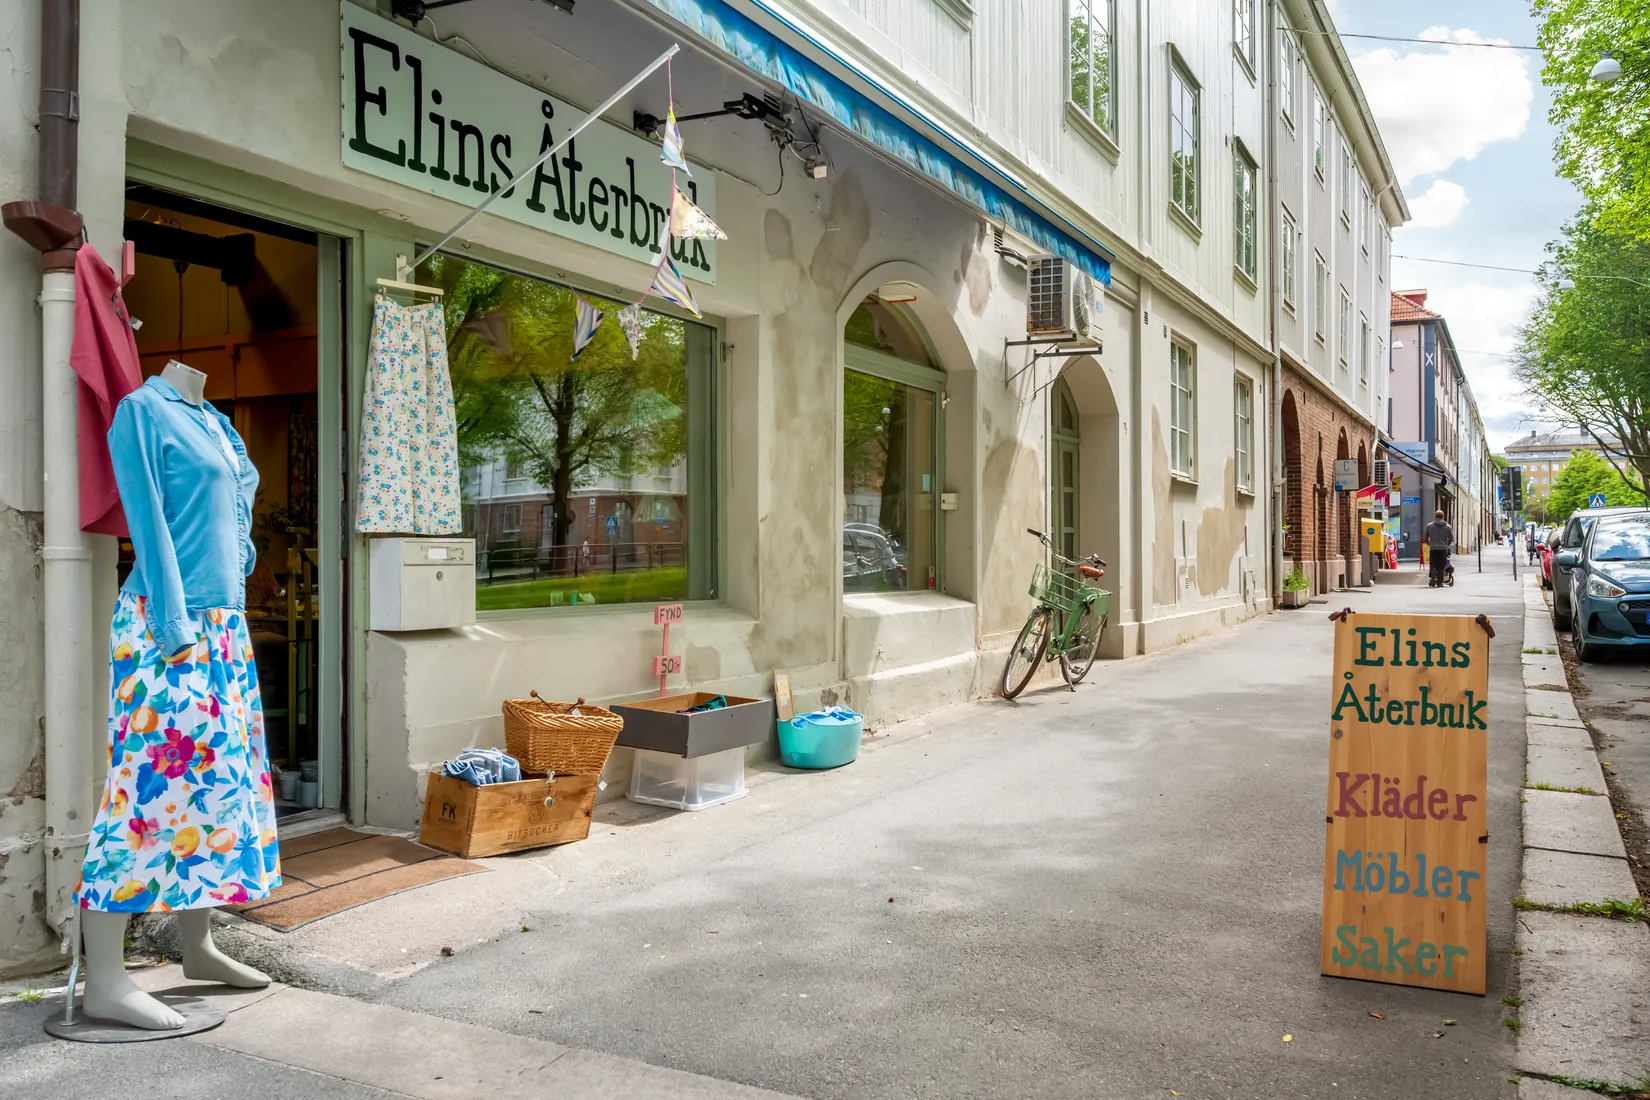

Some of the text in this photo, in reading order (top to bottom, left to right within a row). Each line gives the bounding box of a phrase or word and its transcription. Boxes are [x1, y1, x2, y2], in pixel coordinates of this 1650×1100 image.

[348, 26, 516, 199] Elins
[660, 606, 682, 622] FYND
[1354, 626, 1471, 668] Elins
[1331, 671, 1488, 730] Återbruk
[442, 802, 456, 819] FK
[1333, 771, 1478, 821] Kläder
[507, 823, 560, 840] BITSOCKER
[1333, 849, 1481, 902] Möbler
[1331, 924, 1469, 978] Saker
